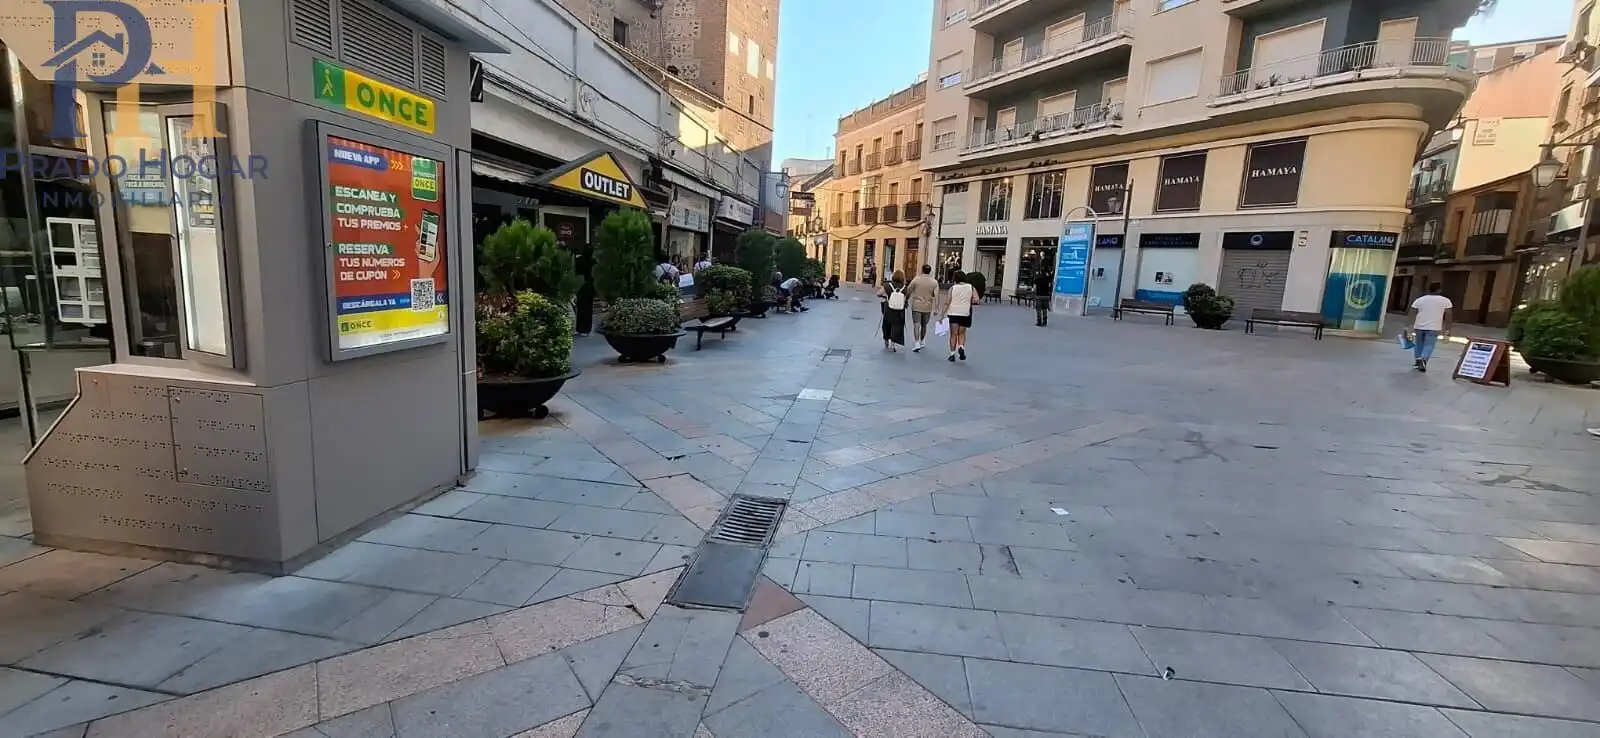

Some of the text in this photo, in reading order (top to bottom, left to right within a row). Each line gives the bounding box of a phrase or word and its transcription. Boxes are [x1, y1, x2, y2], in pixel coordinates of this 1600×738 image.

[356, 82, 428, 127] ONCE
[333, 149, 380, 165] NUEVA APP
[1251, 166, 1298, 178] HAMAYA
[414, 179, 434, 190] ONCE
[584, 171, 631, 199] OUTLET
[1163, 175, 1200, 186] HAMAYA
[1094, 183, 1124, 192] HAMAYA
[335, 185, 397, 203] ESCANEA Y
[336, 203, 401, 218] COMPRUEBA
[337, 218, 401, 231] TUS PREMIOS
[976, 224, 1008, 236] HAMAYA
[338, 243, 390, 255] RESERVA
[340, 256, 405, 268] TUS NÚMEROS
[340, 270, 388, 282] DE CUPÓN
[388, 298, 397, 306] YA
[350, 321, 373, 330] ONCE
